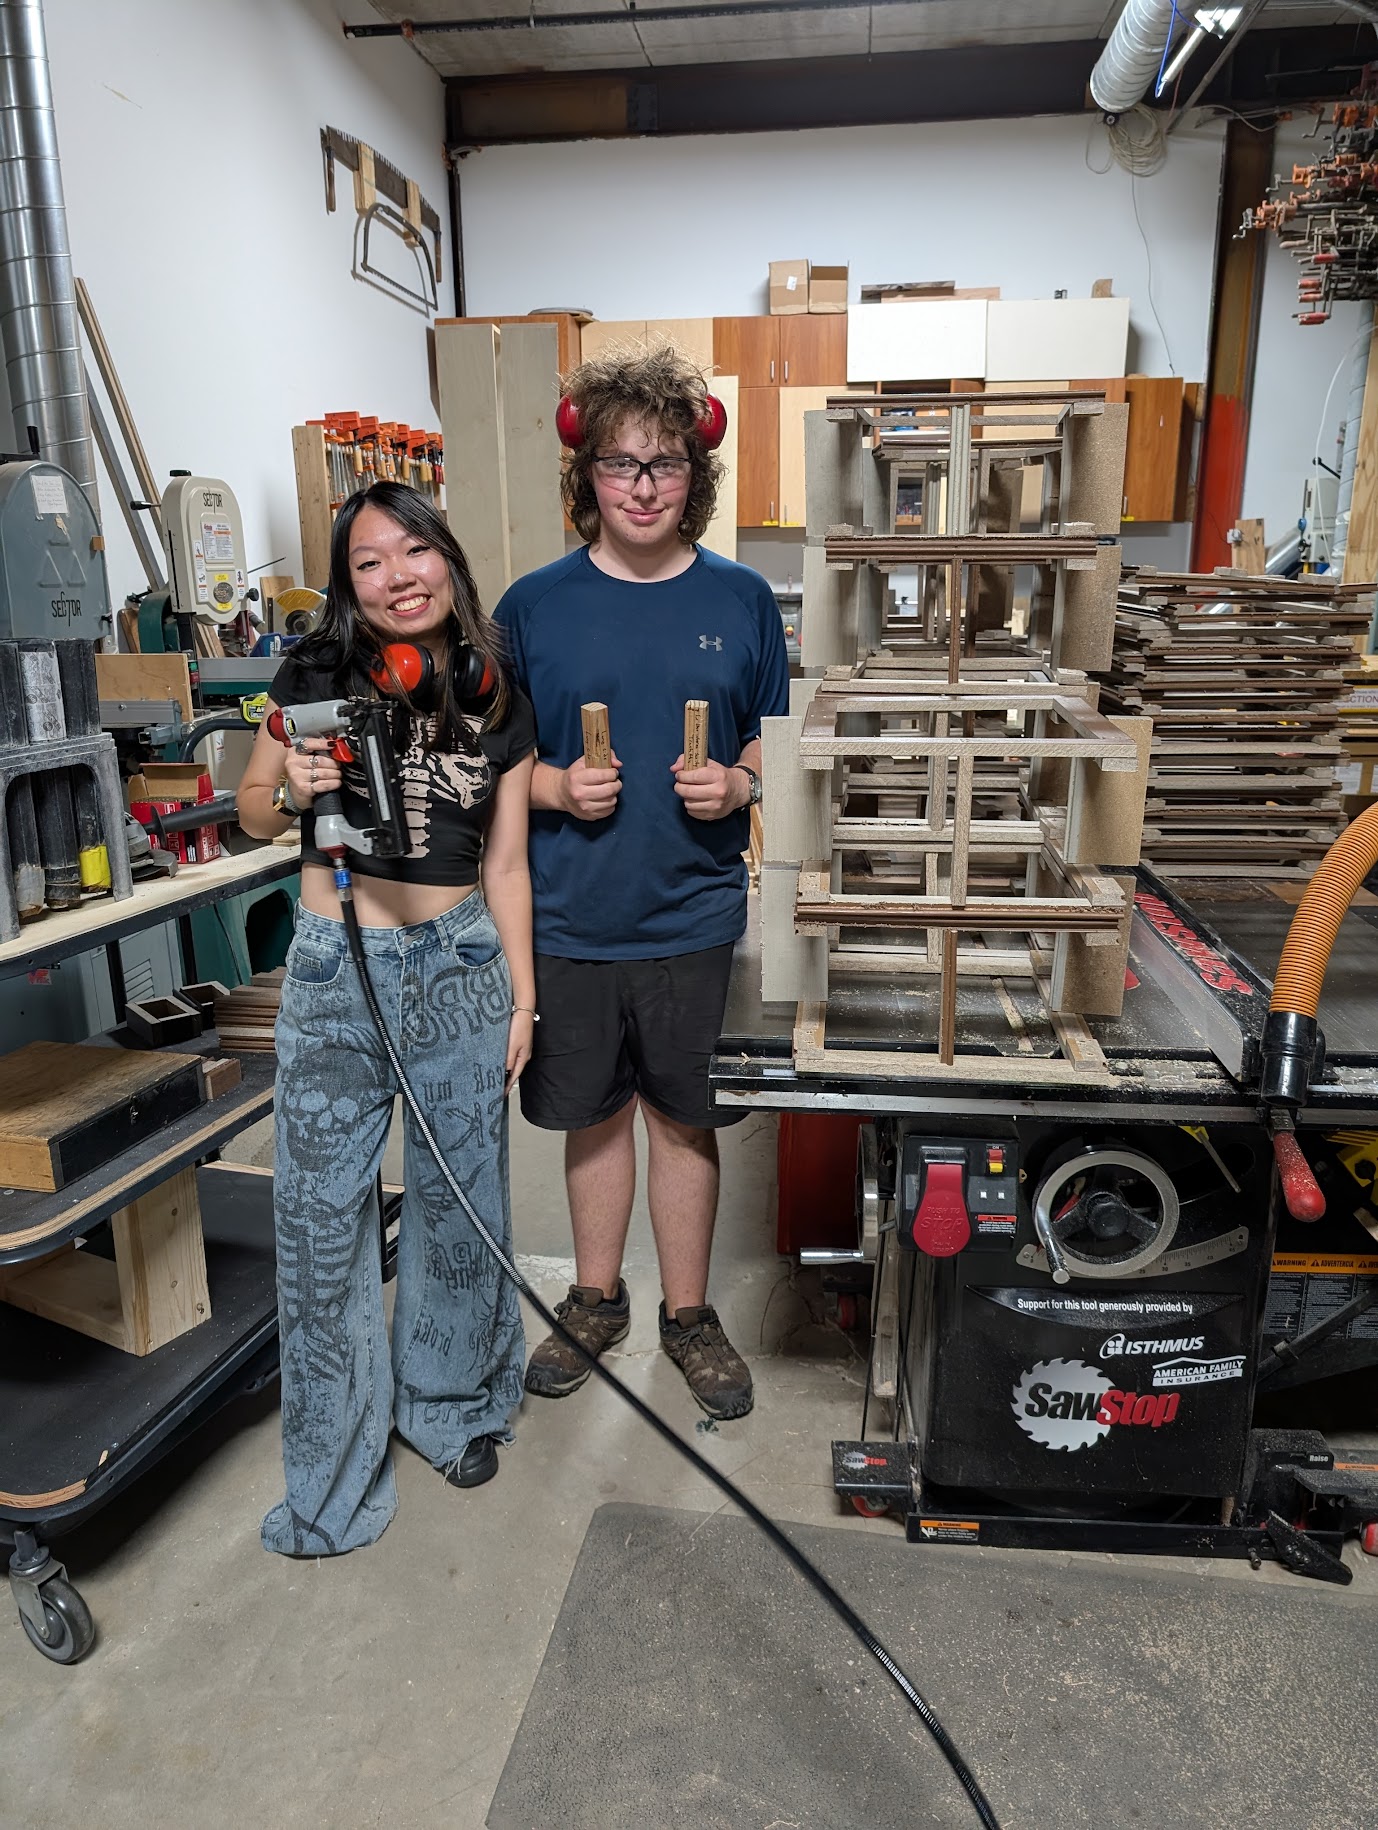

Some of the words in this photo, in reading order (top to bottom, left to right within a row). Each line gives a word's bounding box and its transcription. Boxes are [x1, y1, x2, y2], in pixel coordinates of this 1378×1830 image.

[203, 487, 223, 513] SECTOR
[52, 592, 82, 626] SECTOR
[921, 1217, 963, 1230] STOP
[1276, 1259, 1306, 1267] WARNING
[1017, 1299, 1050, 1310] Support
[1051, 1300, 1063, 1309] for
[1065, 1300, 1080, 1310] this
[1082, 1300, 1097, 1310] tool
[1099, 1301, 1144, 1313] generously
[1146, 1301, 1181, 1313] provided
[1183, 1302, 1193, 1314] by
[1125, 1336, 1205, 1355] ISTHMUS
[1154, 1366, 1206, 1378] AMERICAN
[1208, 1361, 1244, 1374] FAMILY
[1160, 1371, 1236, 1384] INSURANCE
[1025, 1383, 1180, 1427] SawStop
[846, 1456, 887, 1466] SawStop
